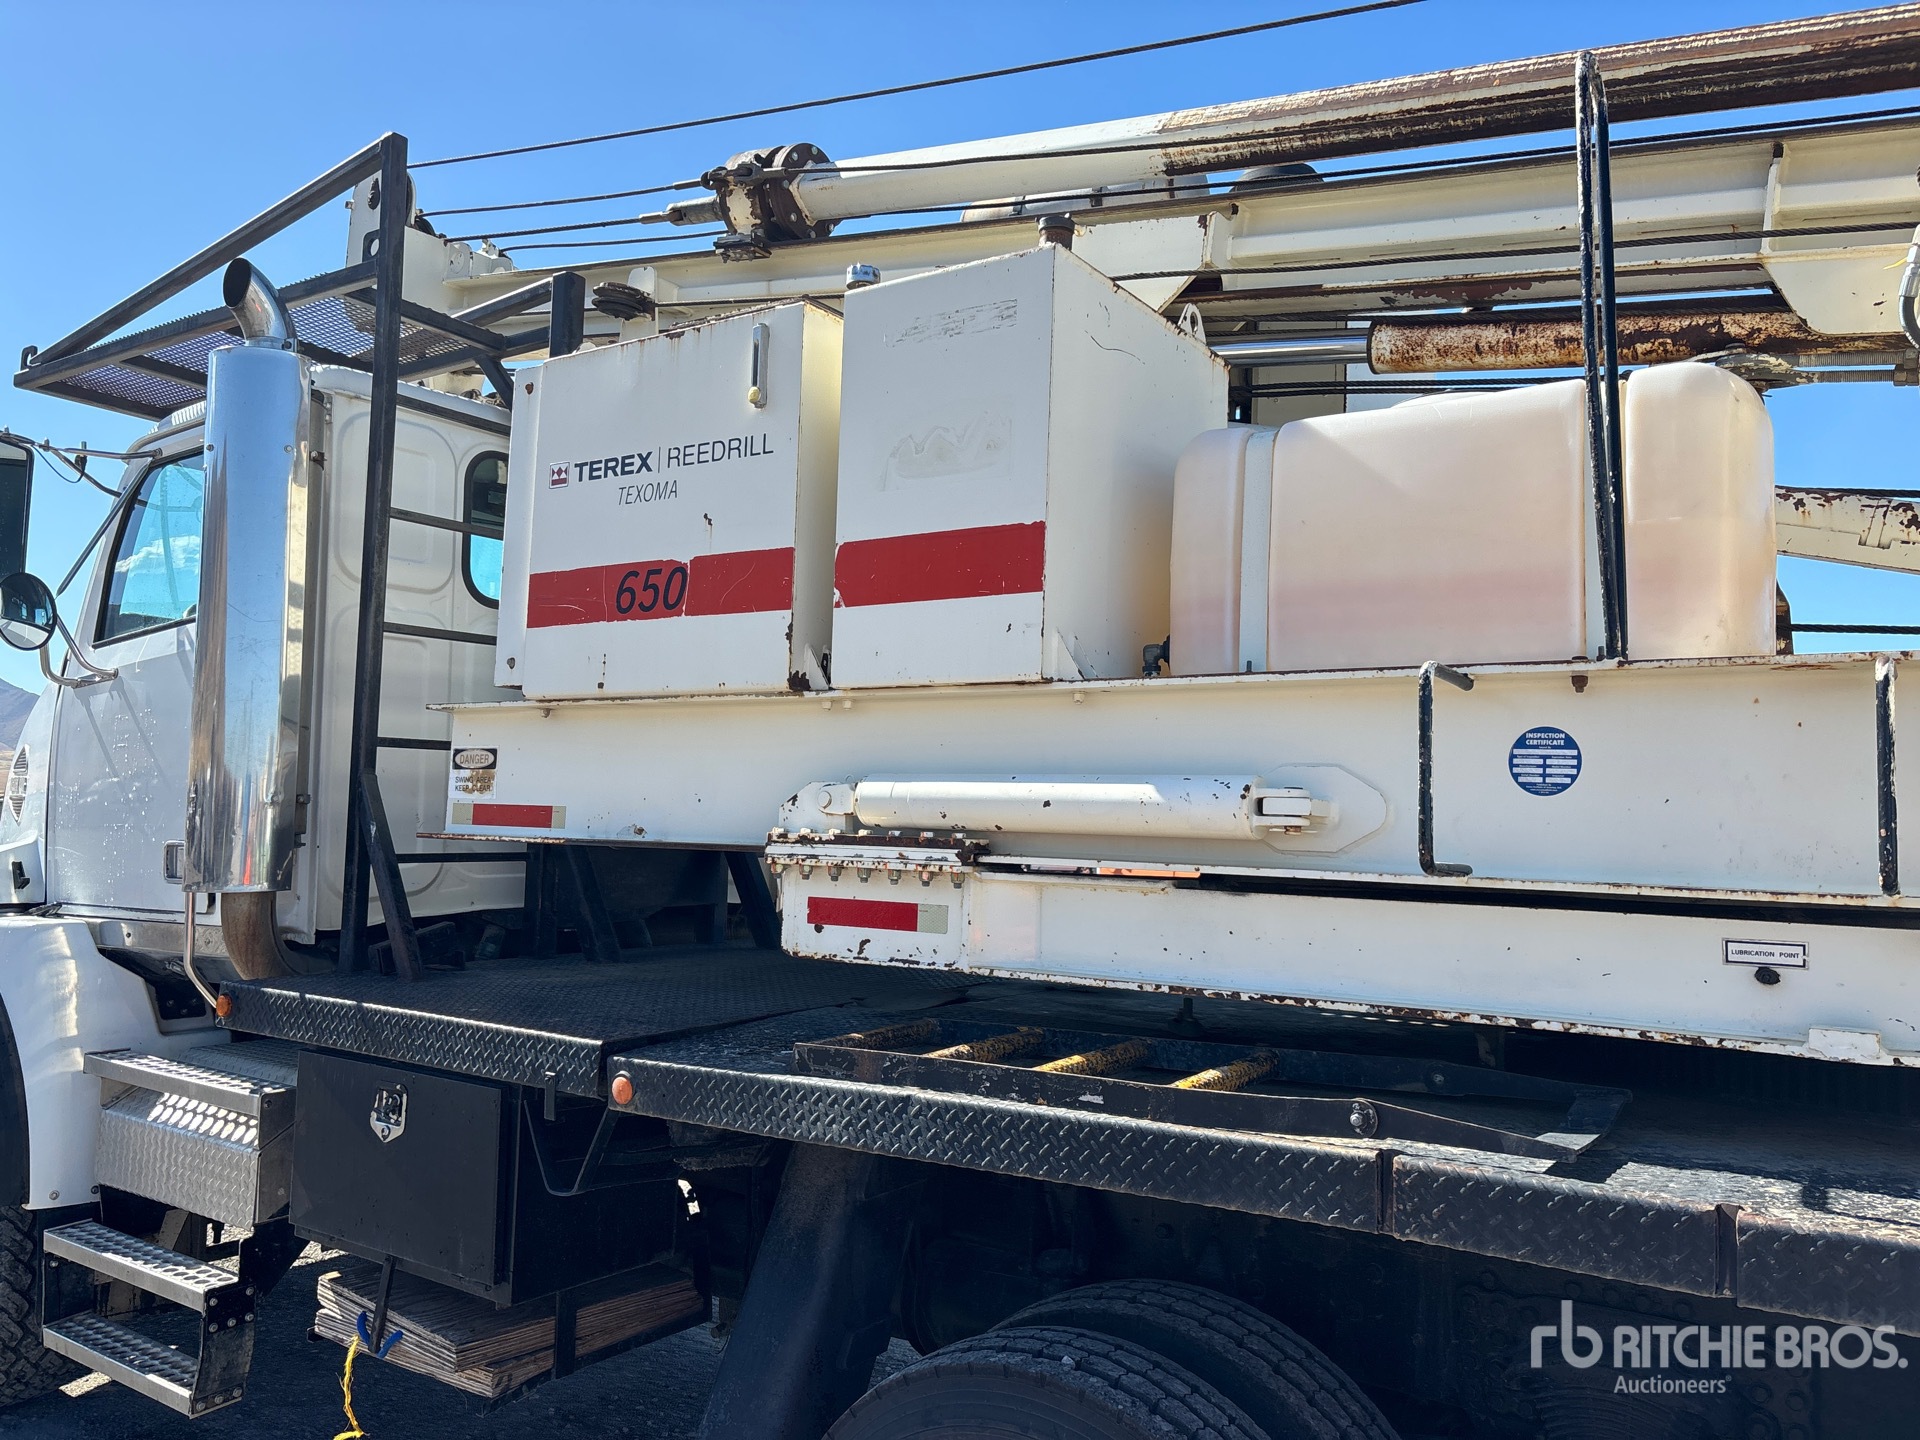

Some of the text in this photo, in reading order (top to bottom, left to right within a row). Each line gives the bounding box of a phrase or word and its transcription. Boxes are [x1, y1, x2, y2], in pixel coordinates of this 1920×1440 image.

[574, 433, 774, 482] TEREX REEDRILL
[618, 480, 678, 506] TEXOMA
[616, 566, 688, 615] 650
[459, 754, 489, 764] DANGER
[455, 776, 473, 784] SWING
[455, 784, 469, 792] KEEP
[1731, 949, 1775, 958] LUBRICATION
